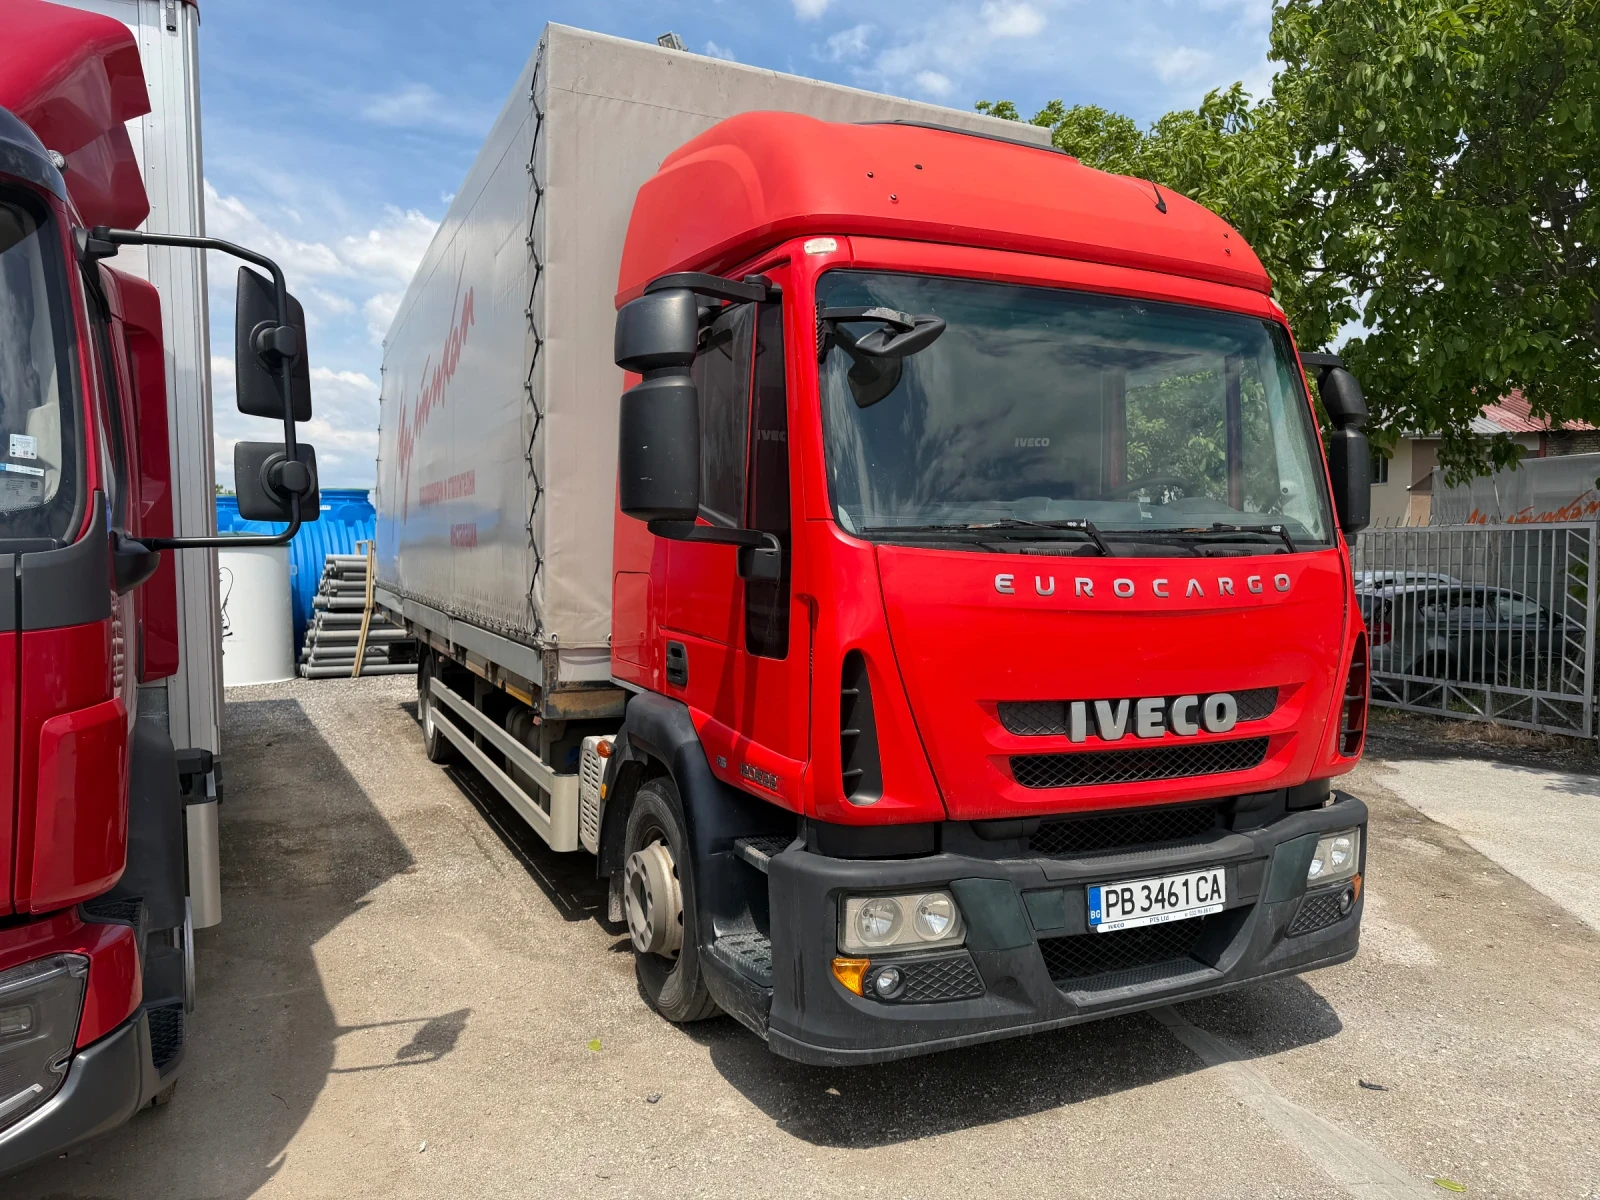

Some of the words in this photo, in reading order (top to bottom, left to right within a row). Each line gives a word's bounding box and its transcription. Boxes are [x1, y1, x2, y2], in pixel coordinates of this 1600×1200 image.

[757, 430, 787, 442] IVEC
[1014, 437, 1050, 448] IVECO
[994, 573, 1291, 598] EUROCARGO
[1066, 692, 1238, 743] IVECO
[1090, 910, 1101, 919] BG
[1105, 887, 1136, 918] PB
[1141, 881, 1189, 911] 3461
[1196, 873, 1222, 903] CA
